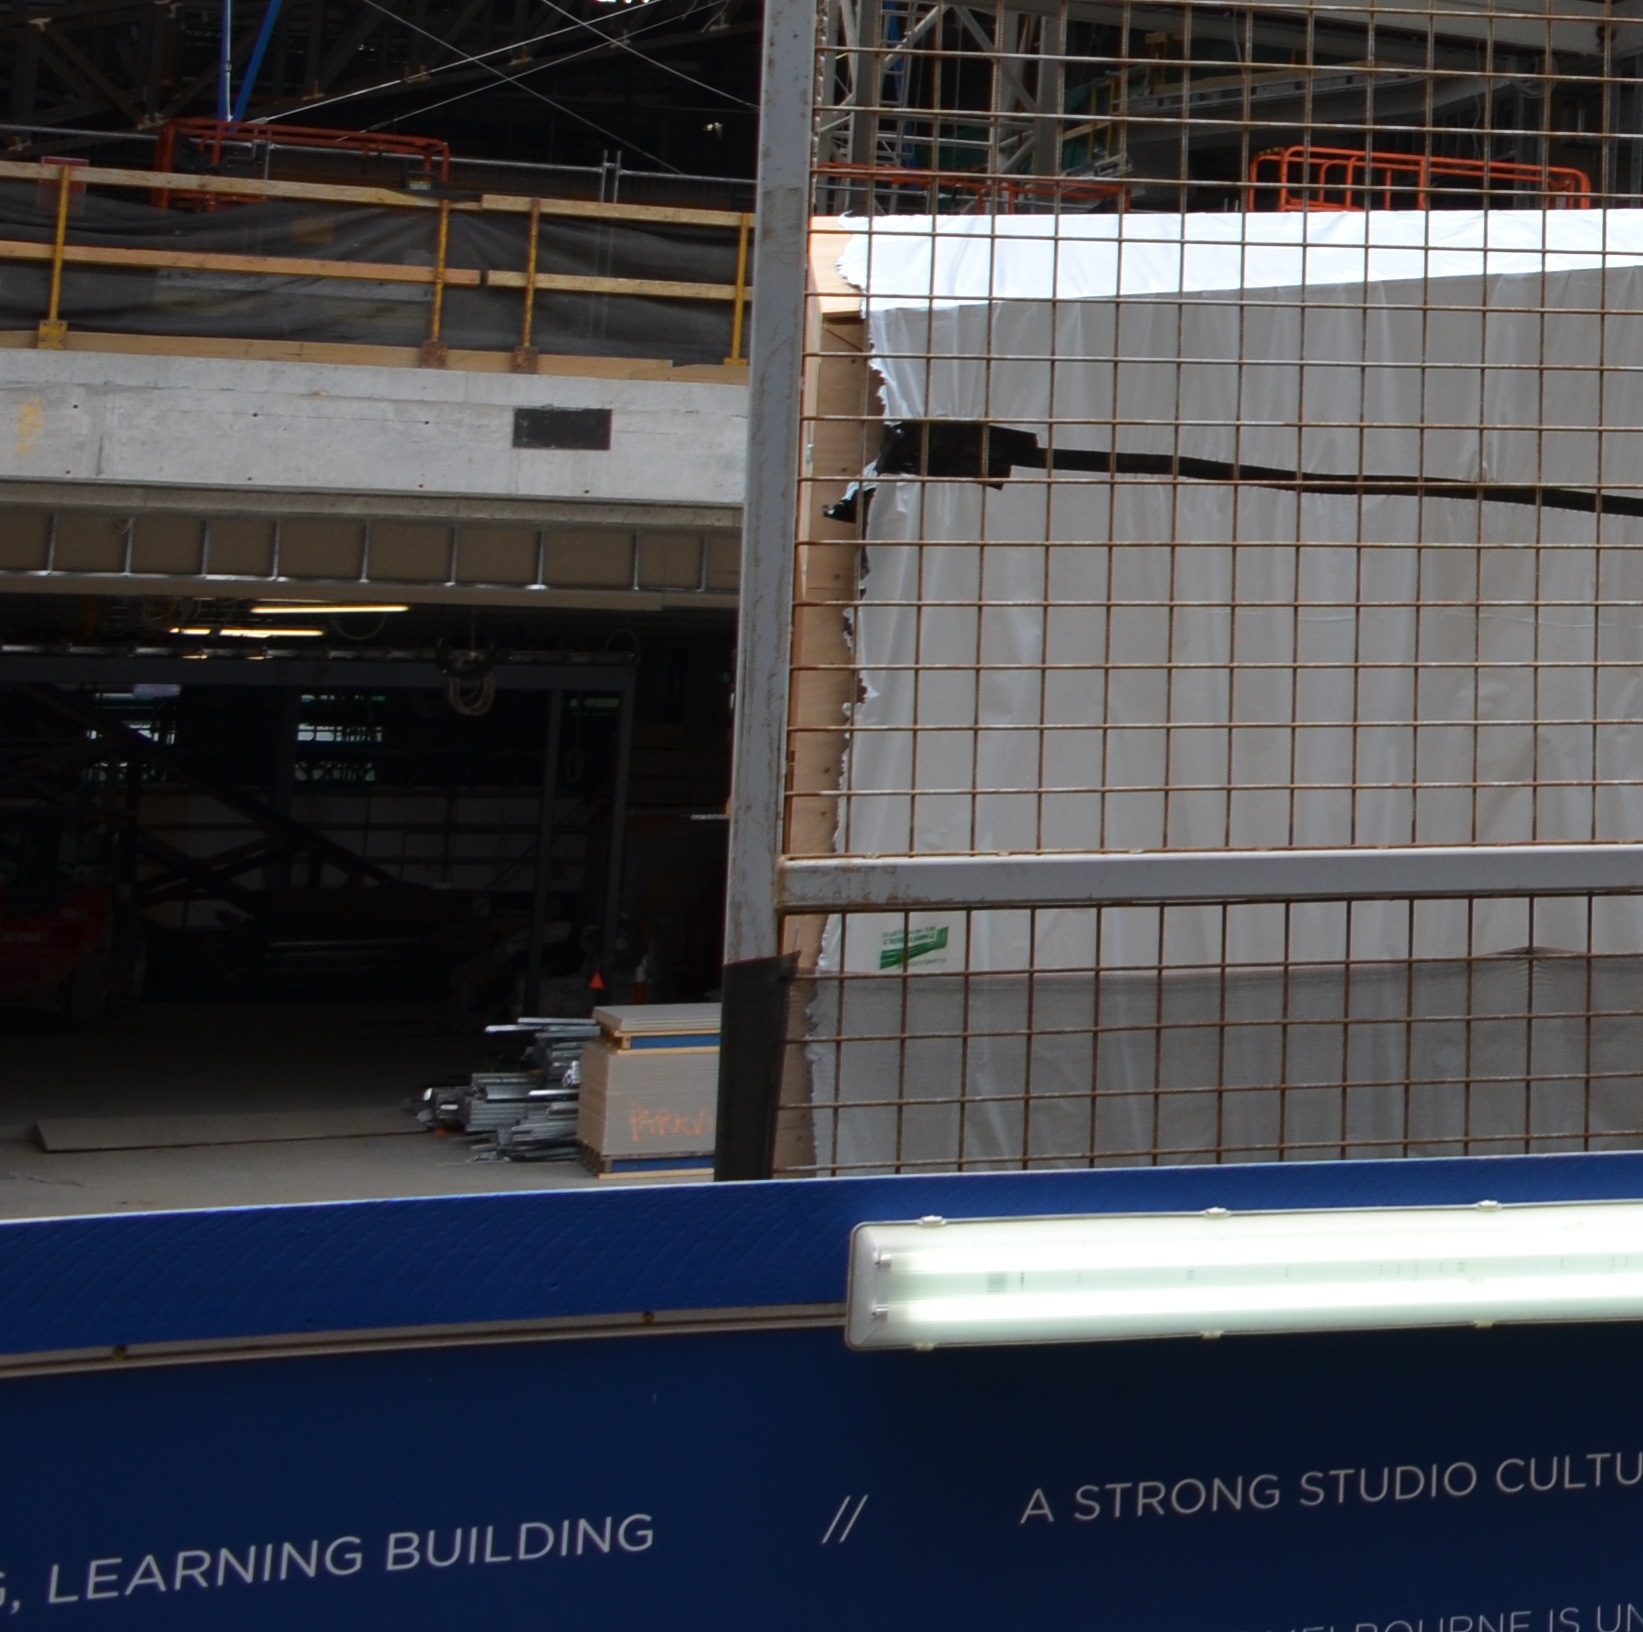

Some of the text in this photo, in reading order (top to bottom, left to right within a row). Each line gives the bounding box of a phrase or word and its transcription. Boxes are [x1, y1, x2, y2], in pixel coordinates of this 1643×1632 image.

[48, 1535, 363, 1606] LEARNING
[386, 1512, 655, 1571] BUILDING
[1019, 1488, 1055, 1524] A
[1073, 1473, 1281, 1523] STRONG
[1300, 1459, 1478, 1509] STUDIO
[1548, 1607, 1579, 1632] IS
